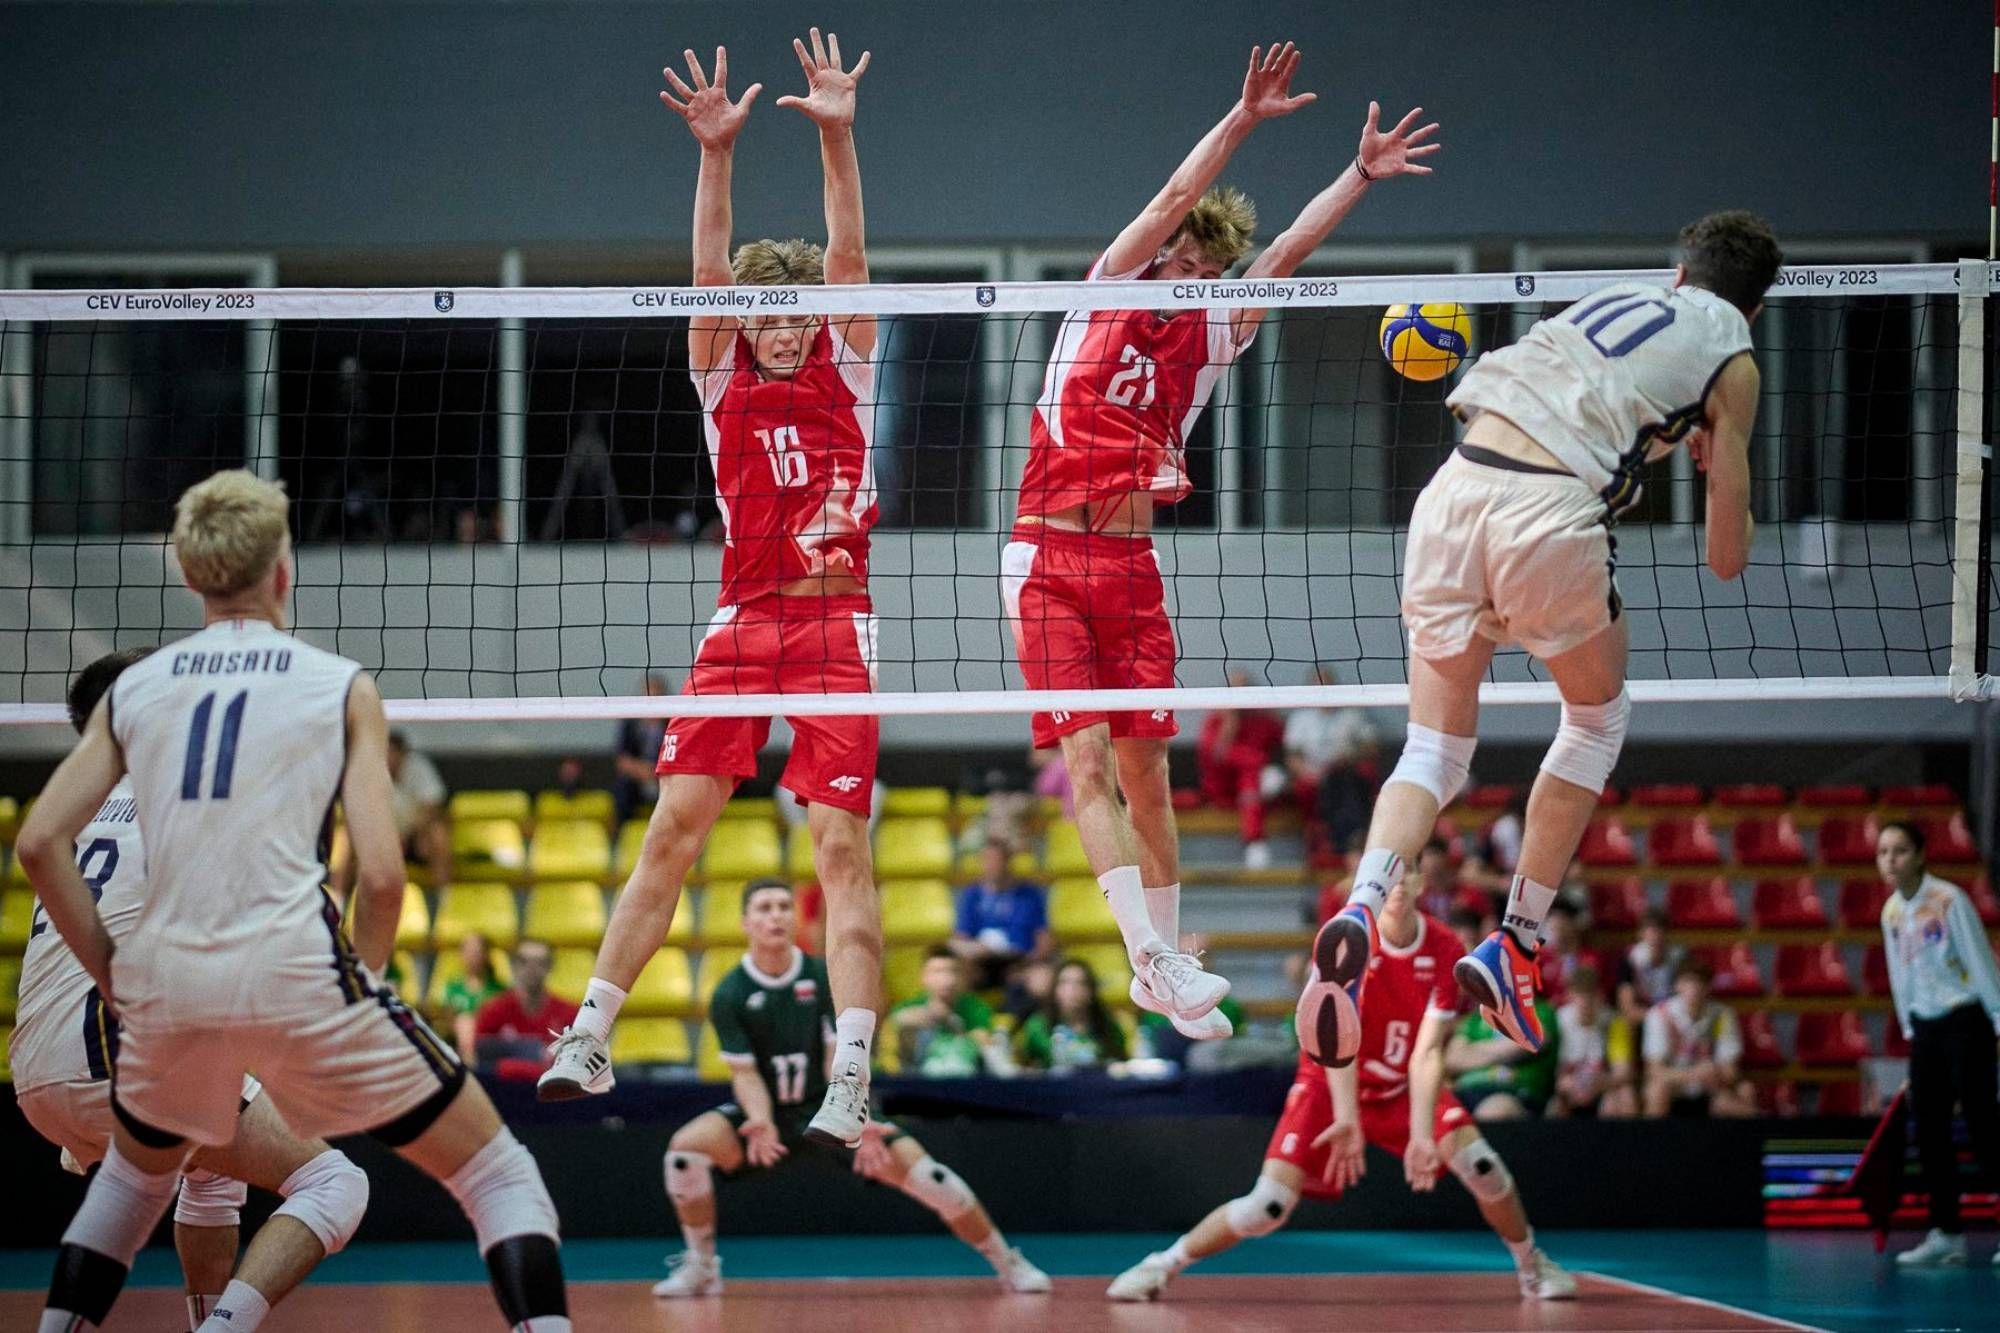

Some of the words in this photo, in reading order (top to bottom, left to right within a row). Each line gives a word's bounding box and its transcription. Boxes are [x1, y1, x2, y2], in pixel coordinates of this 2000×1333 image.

[1173, 285, 1207, 299] CEV
[1211, 282, 1295, 301] EuroVolley
[1299, 282, 1338, 297] 2023
[1777, 270, 1834, 288] oVolley
[1839, 270, 1878, 285] 2023
[87, 295, 121, 310] CEV
[125, 294, 212, 312] EuroVolley
[215, 294, 255, 309] 2023
[632, 293, 666, 307] CEV
[670, 291, 755, 309] EuroVolley
[759, 290, 798, 305] 2023
[1568, 291, 1676, 358] 10
[1105, 344, 1156, 411] 21
[753, 425, 808, 487] 16
[172, 650, 291, 676] CROSATO
[181, 689, 248, 799] 11
[661, 734, 678, 762] 16
[828, 775, 863, 792] 4F
[1384, 1020, 1410, 1066] 6
[771, 1052, 808, 1102] 17
